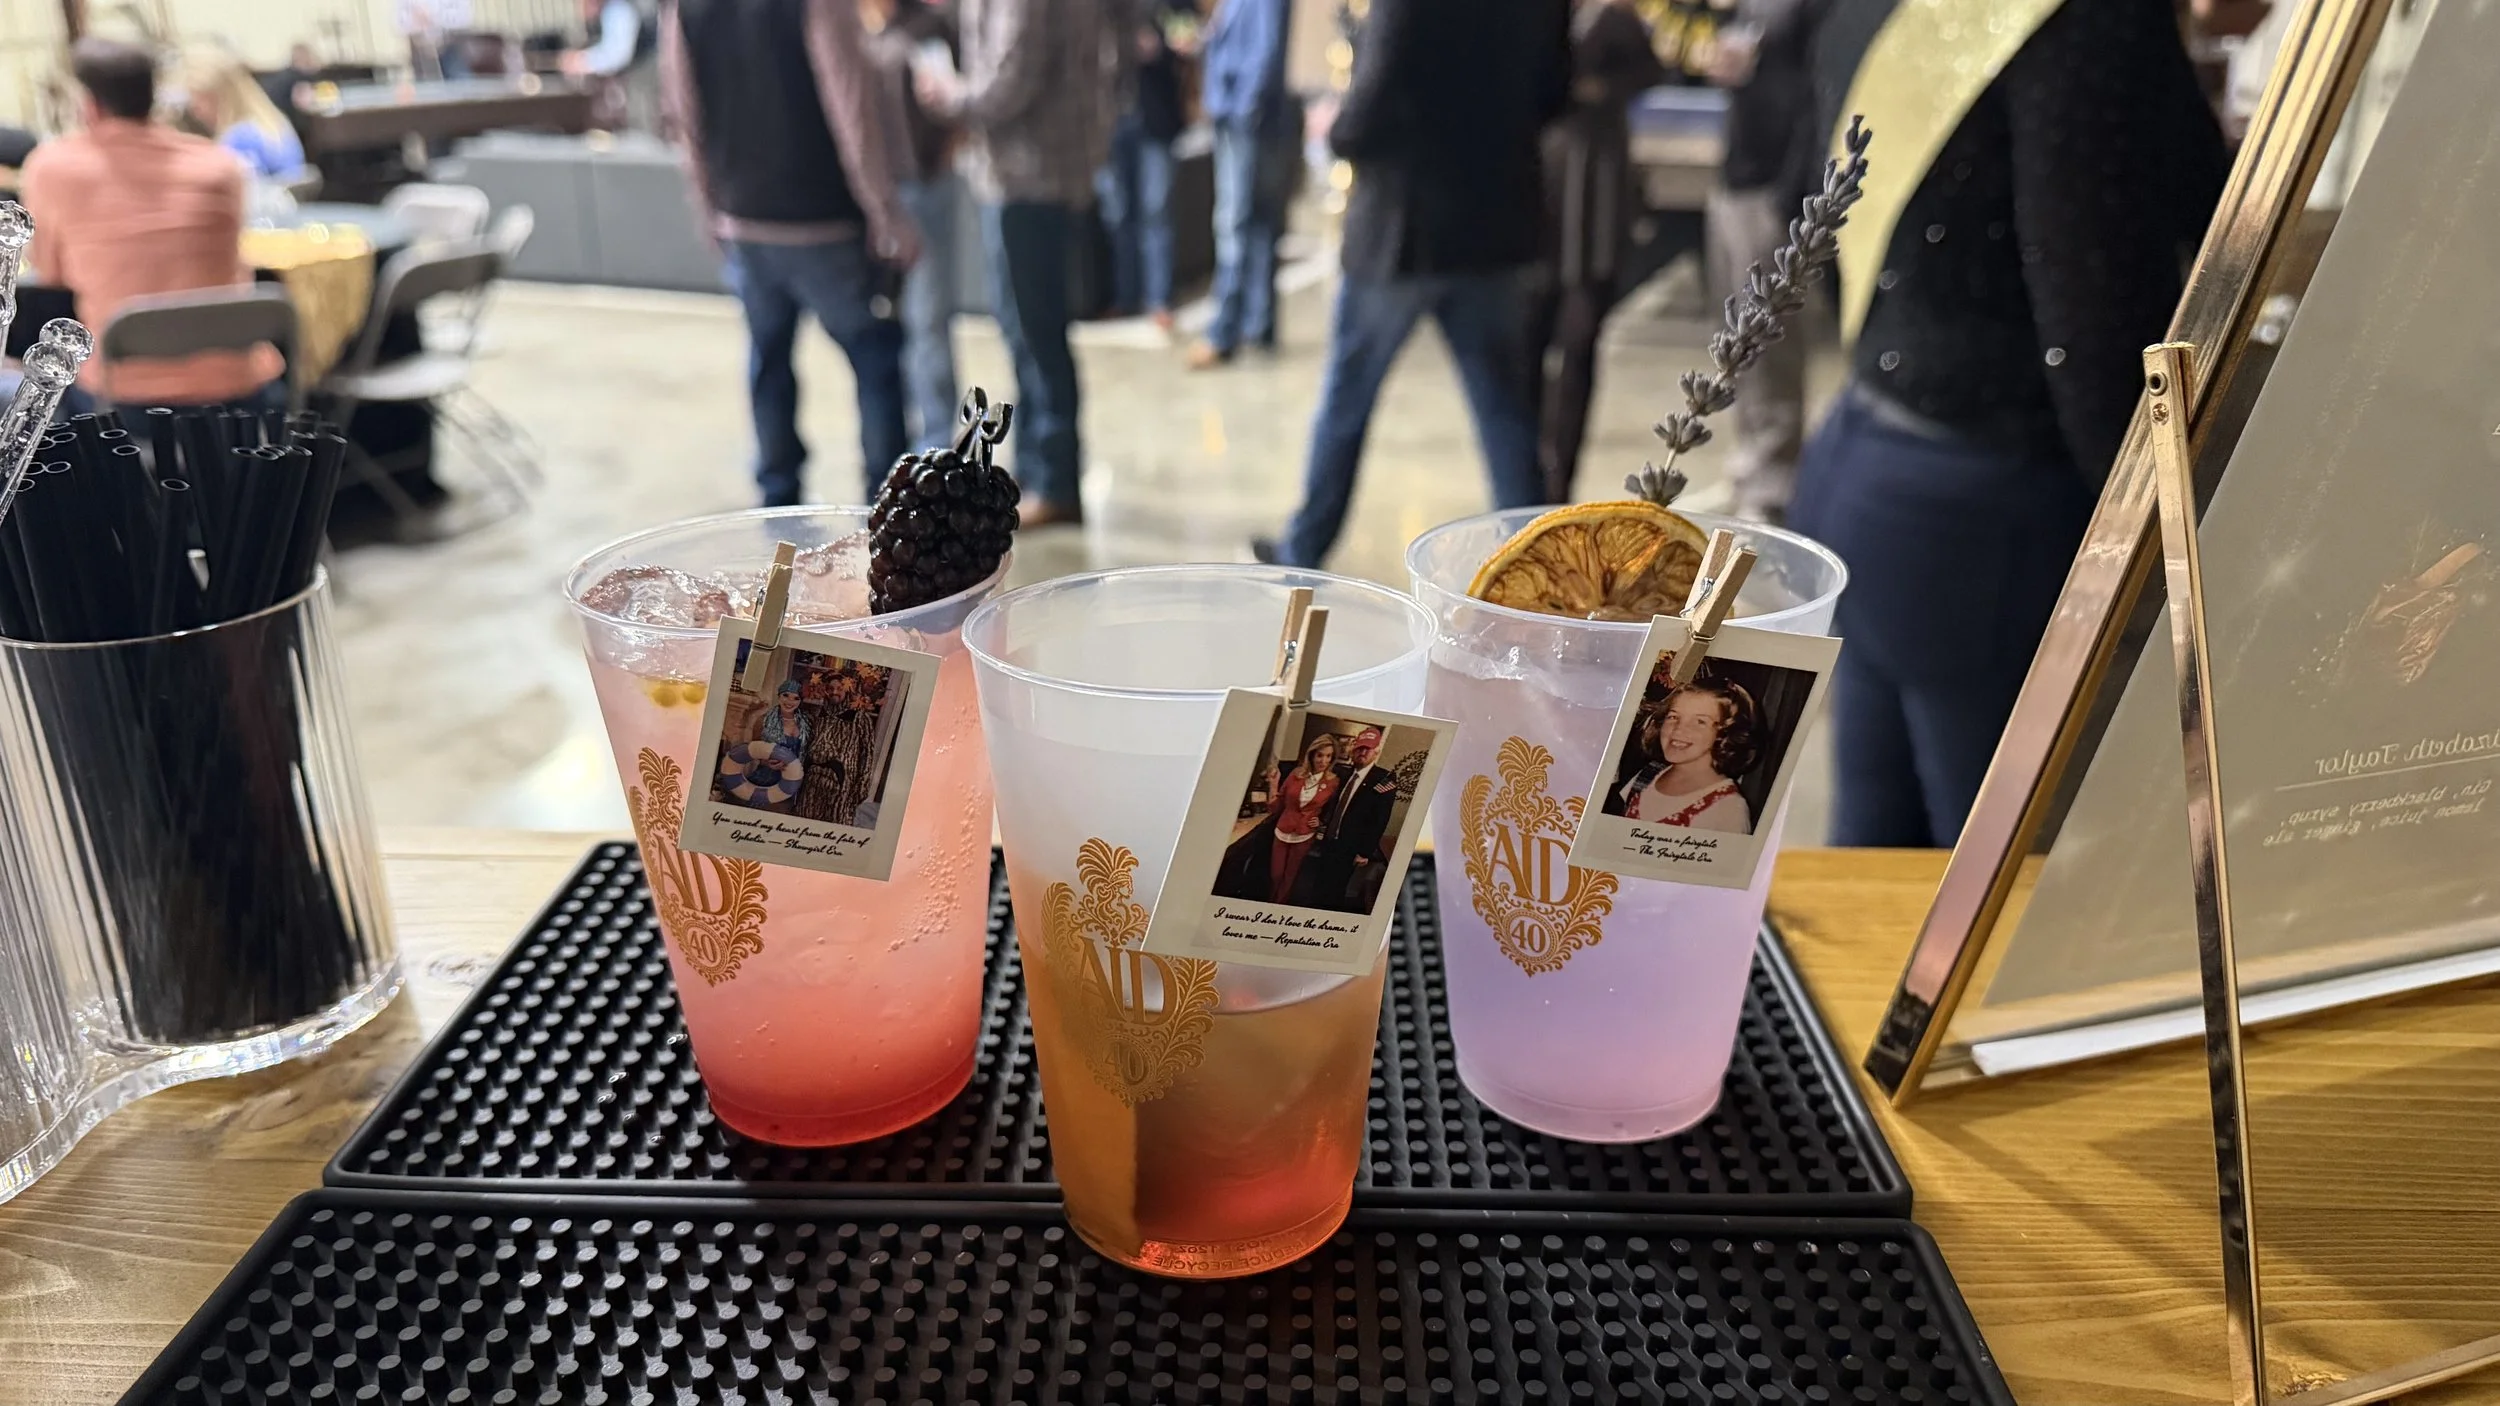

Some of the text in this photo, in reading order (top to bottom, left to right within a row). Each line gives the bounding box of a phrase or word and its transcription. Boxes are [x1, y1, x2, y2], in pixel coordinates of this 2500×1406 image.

[712, 811, 871, 848] You saved my heart from the fate of
[1630, 828, 1655, 844] Today
[1679, 836, 1718, 850] fairytale
[730, 830, 766, 844] Ophelia
[784, 838, 825, 855] Showgirl
[826, 846, 843, 856] Era
[1639, 844, 1654, 856] The
[1657, 847, 1695, 862] Fairytale
[1697, 852, 1713, 863] Era
[1213, 907, 1360, 933] I swear I don't love the drama, it
[689, 930, 718, 963] 40
[1222, 926, 1243, 939] loves
[1274, 932, 1321, 948] Reputation
[1323, 937, 1339, 949] Era
[1511, 919, 1546, 953] 40
